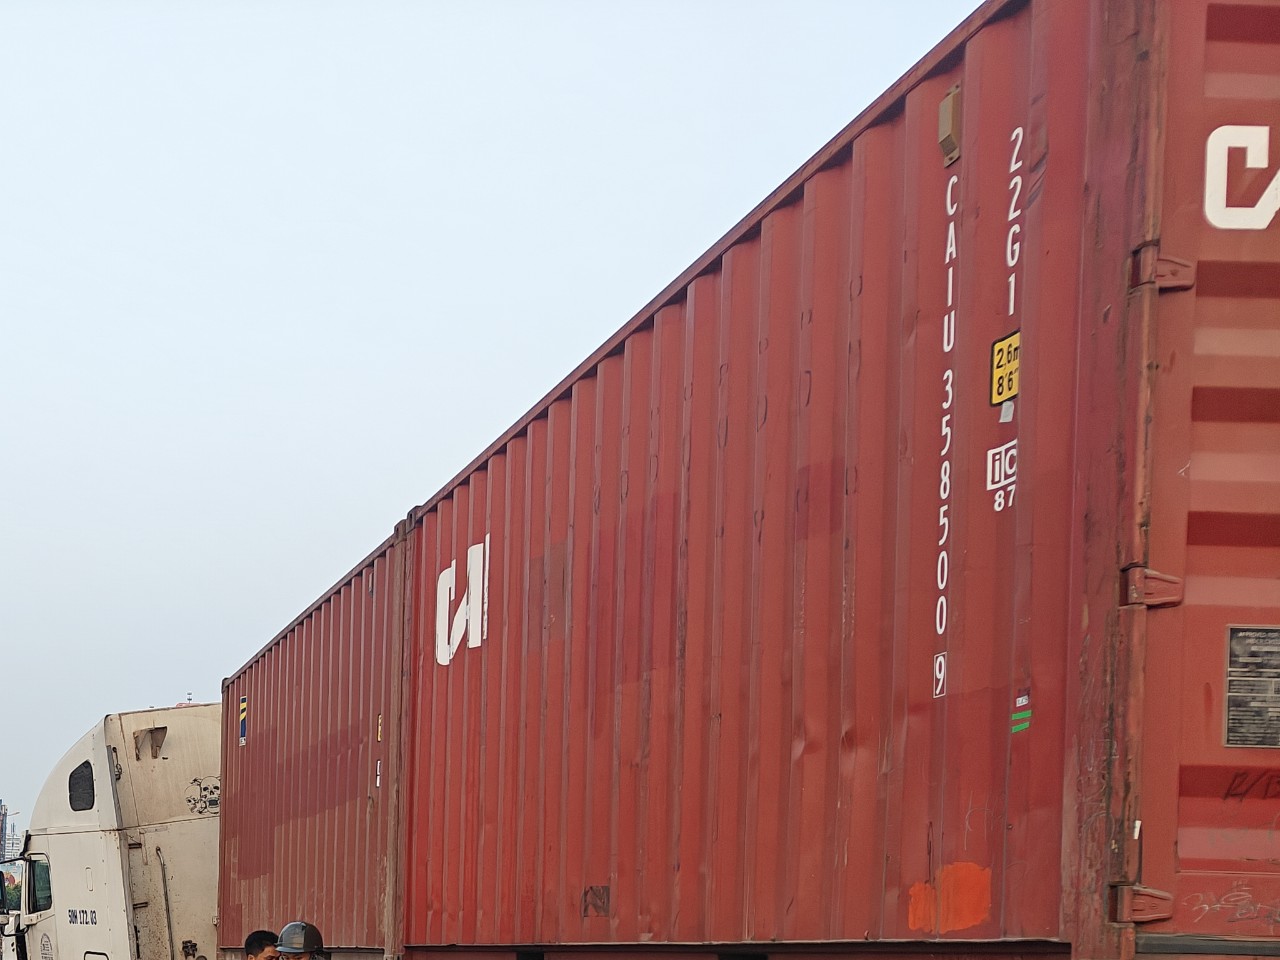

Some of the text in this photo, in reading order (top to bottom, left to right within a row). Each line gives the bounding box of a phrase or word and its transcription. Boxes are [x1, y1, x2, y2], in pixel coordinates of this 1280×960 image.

[1006, 126, 1025, 317] 22G1
[934, 174, 959, 697] CAIU 358500 9
